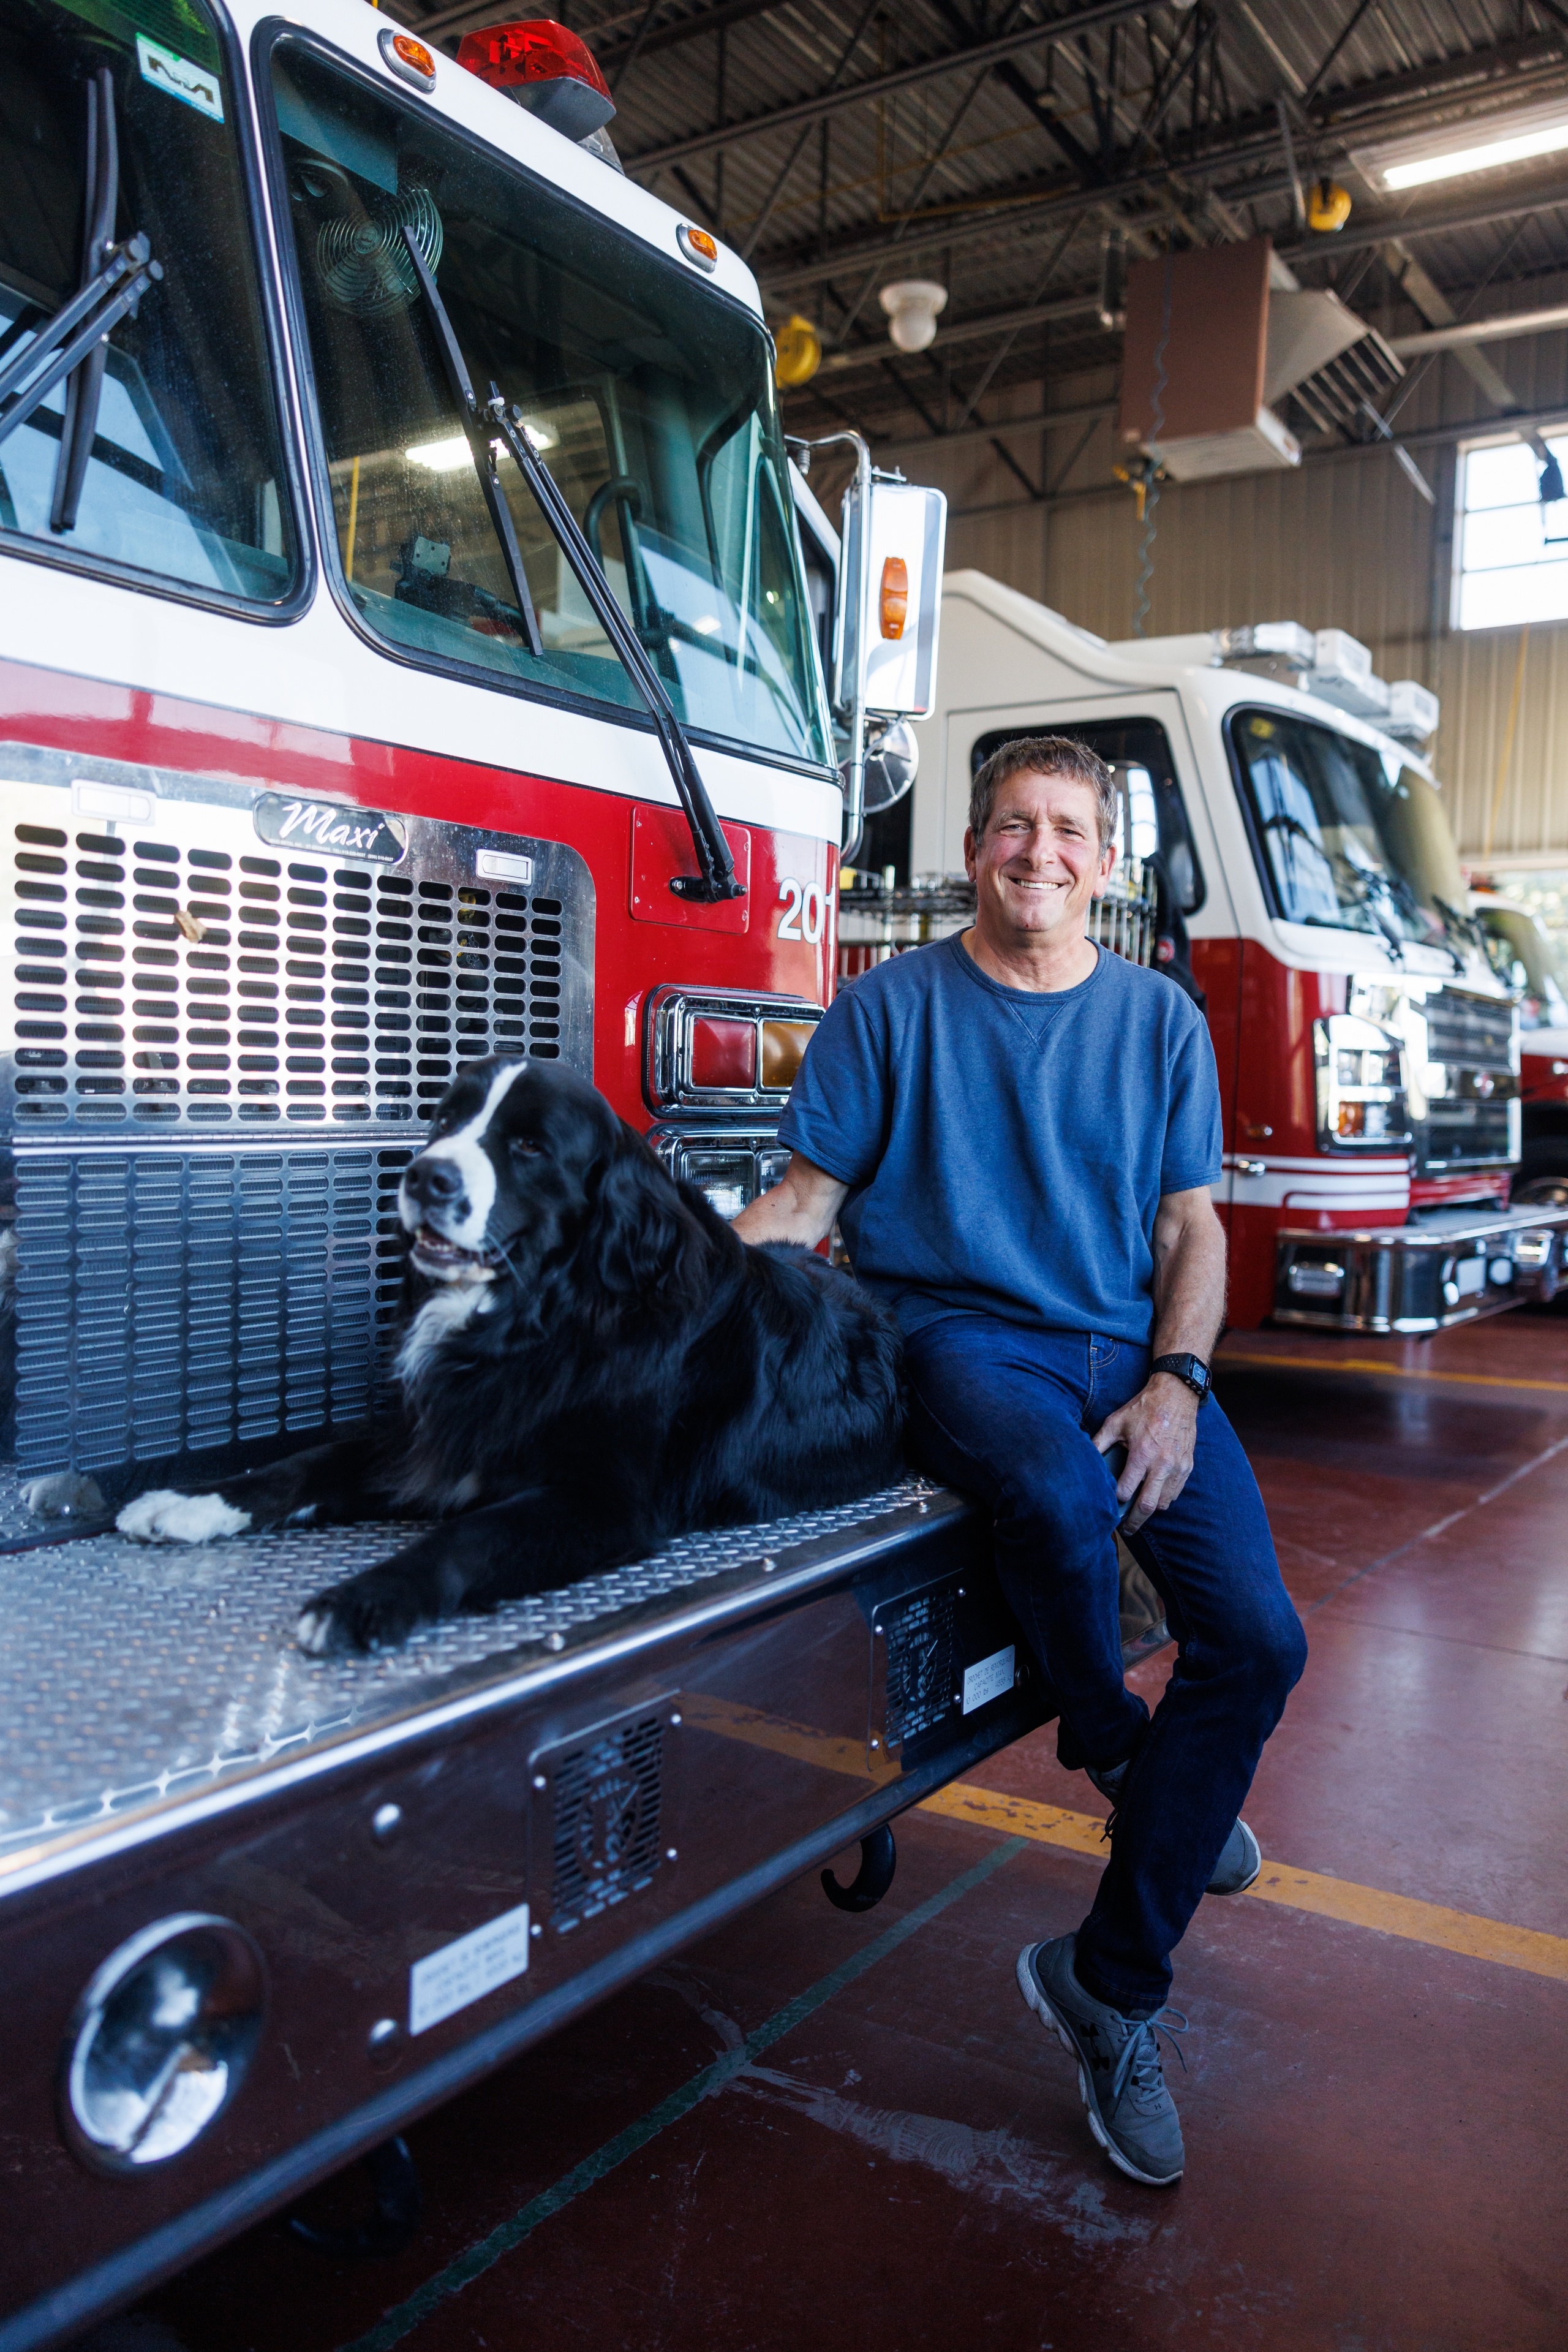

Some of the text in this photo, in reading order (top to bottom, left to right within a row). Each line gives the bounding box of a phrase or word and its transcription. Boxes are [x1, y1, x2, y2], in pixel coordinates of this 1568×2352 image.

[279, 802, 385, 850] Maxi
[777, 877, 836, 946] 201
[984, 1666, 989, 1675] DE
